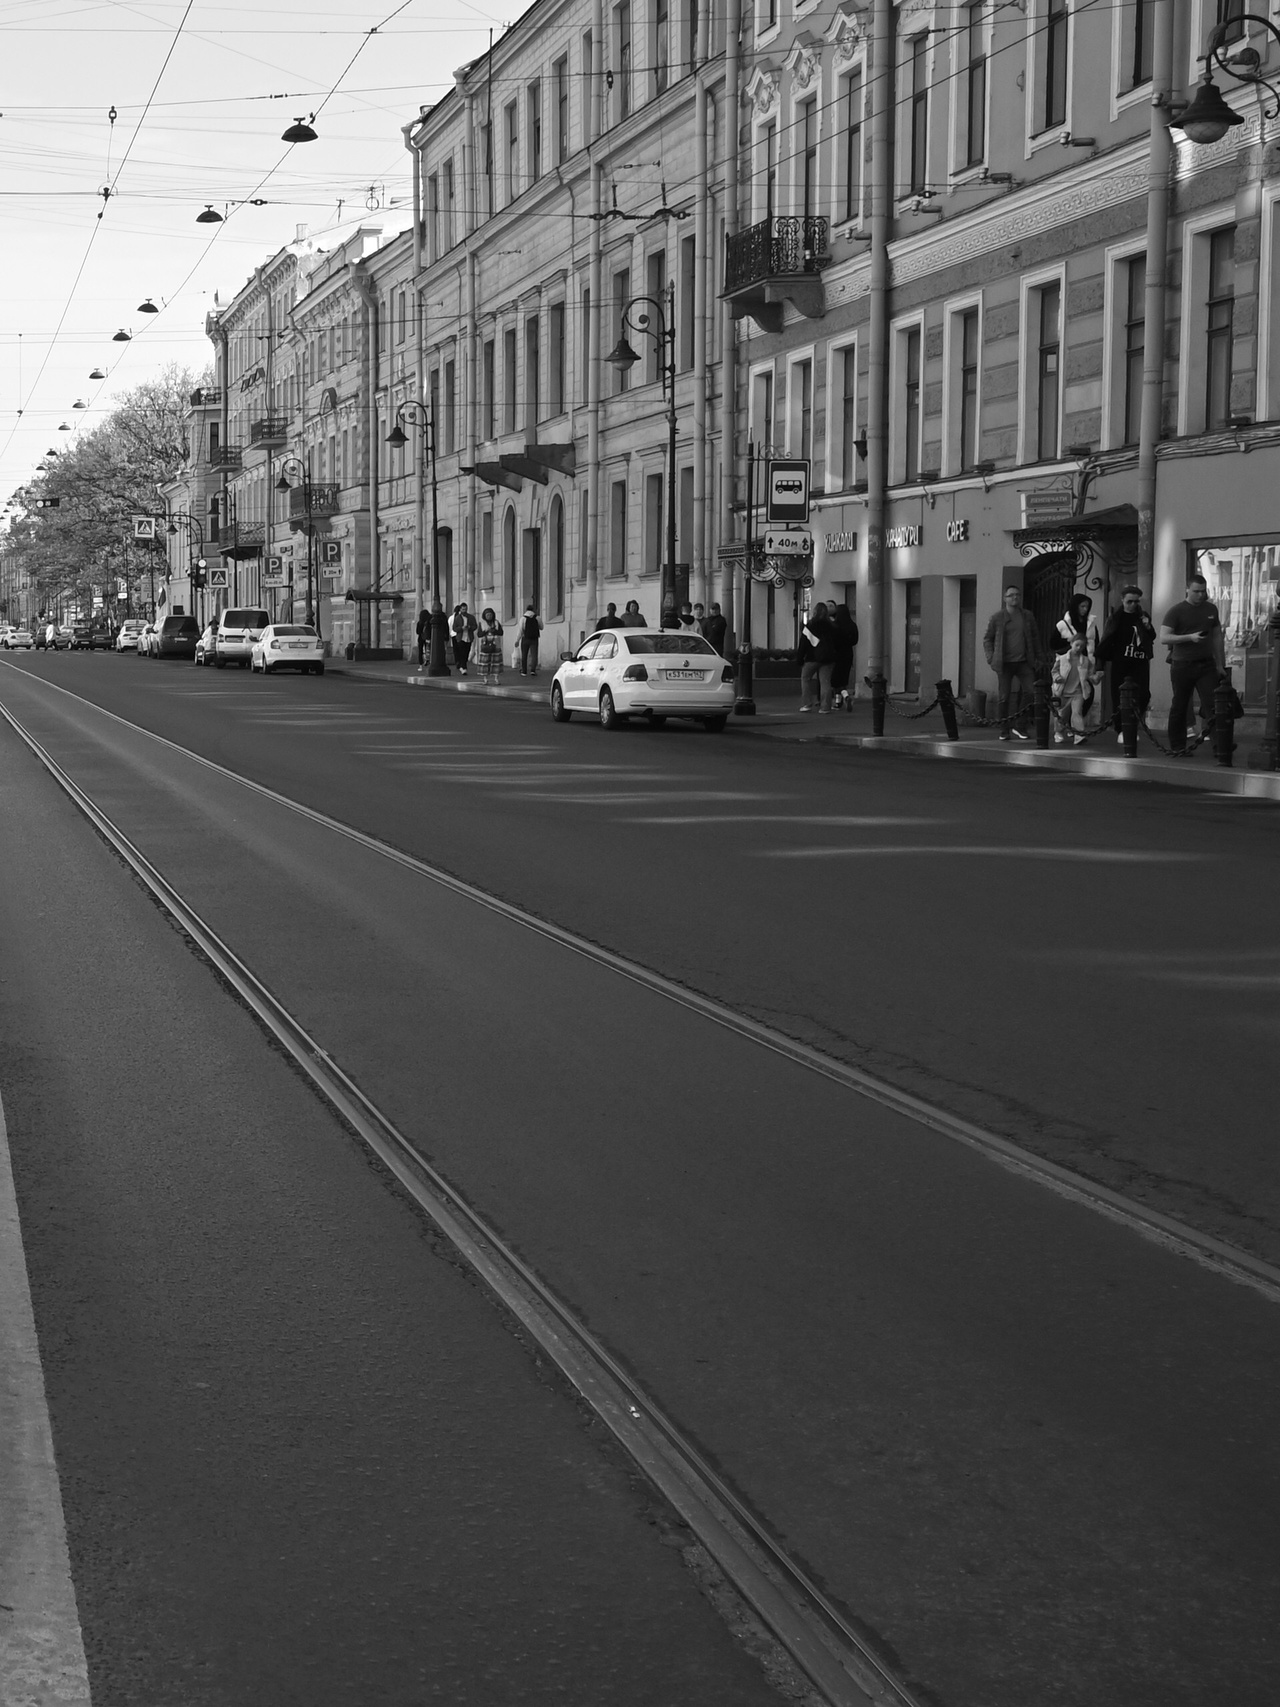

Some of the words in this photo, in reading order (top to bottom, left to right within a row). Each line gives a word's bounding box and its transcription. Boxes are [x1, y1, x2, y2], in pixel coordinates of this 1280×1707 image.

[885, 524, 920, 548] ХАЧАПУРИ
[946, 519, 966, 542] CAFE
[327, 543, 338, 561] P
[824, 531, 854, 553] ХИНКАЛИ
[269, 558, 280, 573] P
[1124, 645, 1147, 659] Hea
